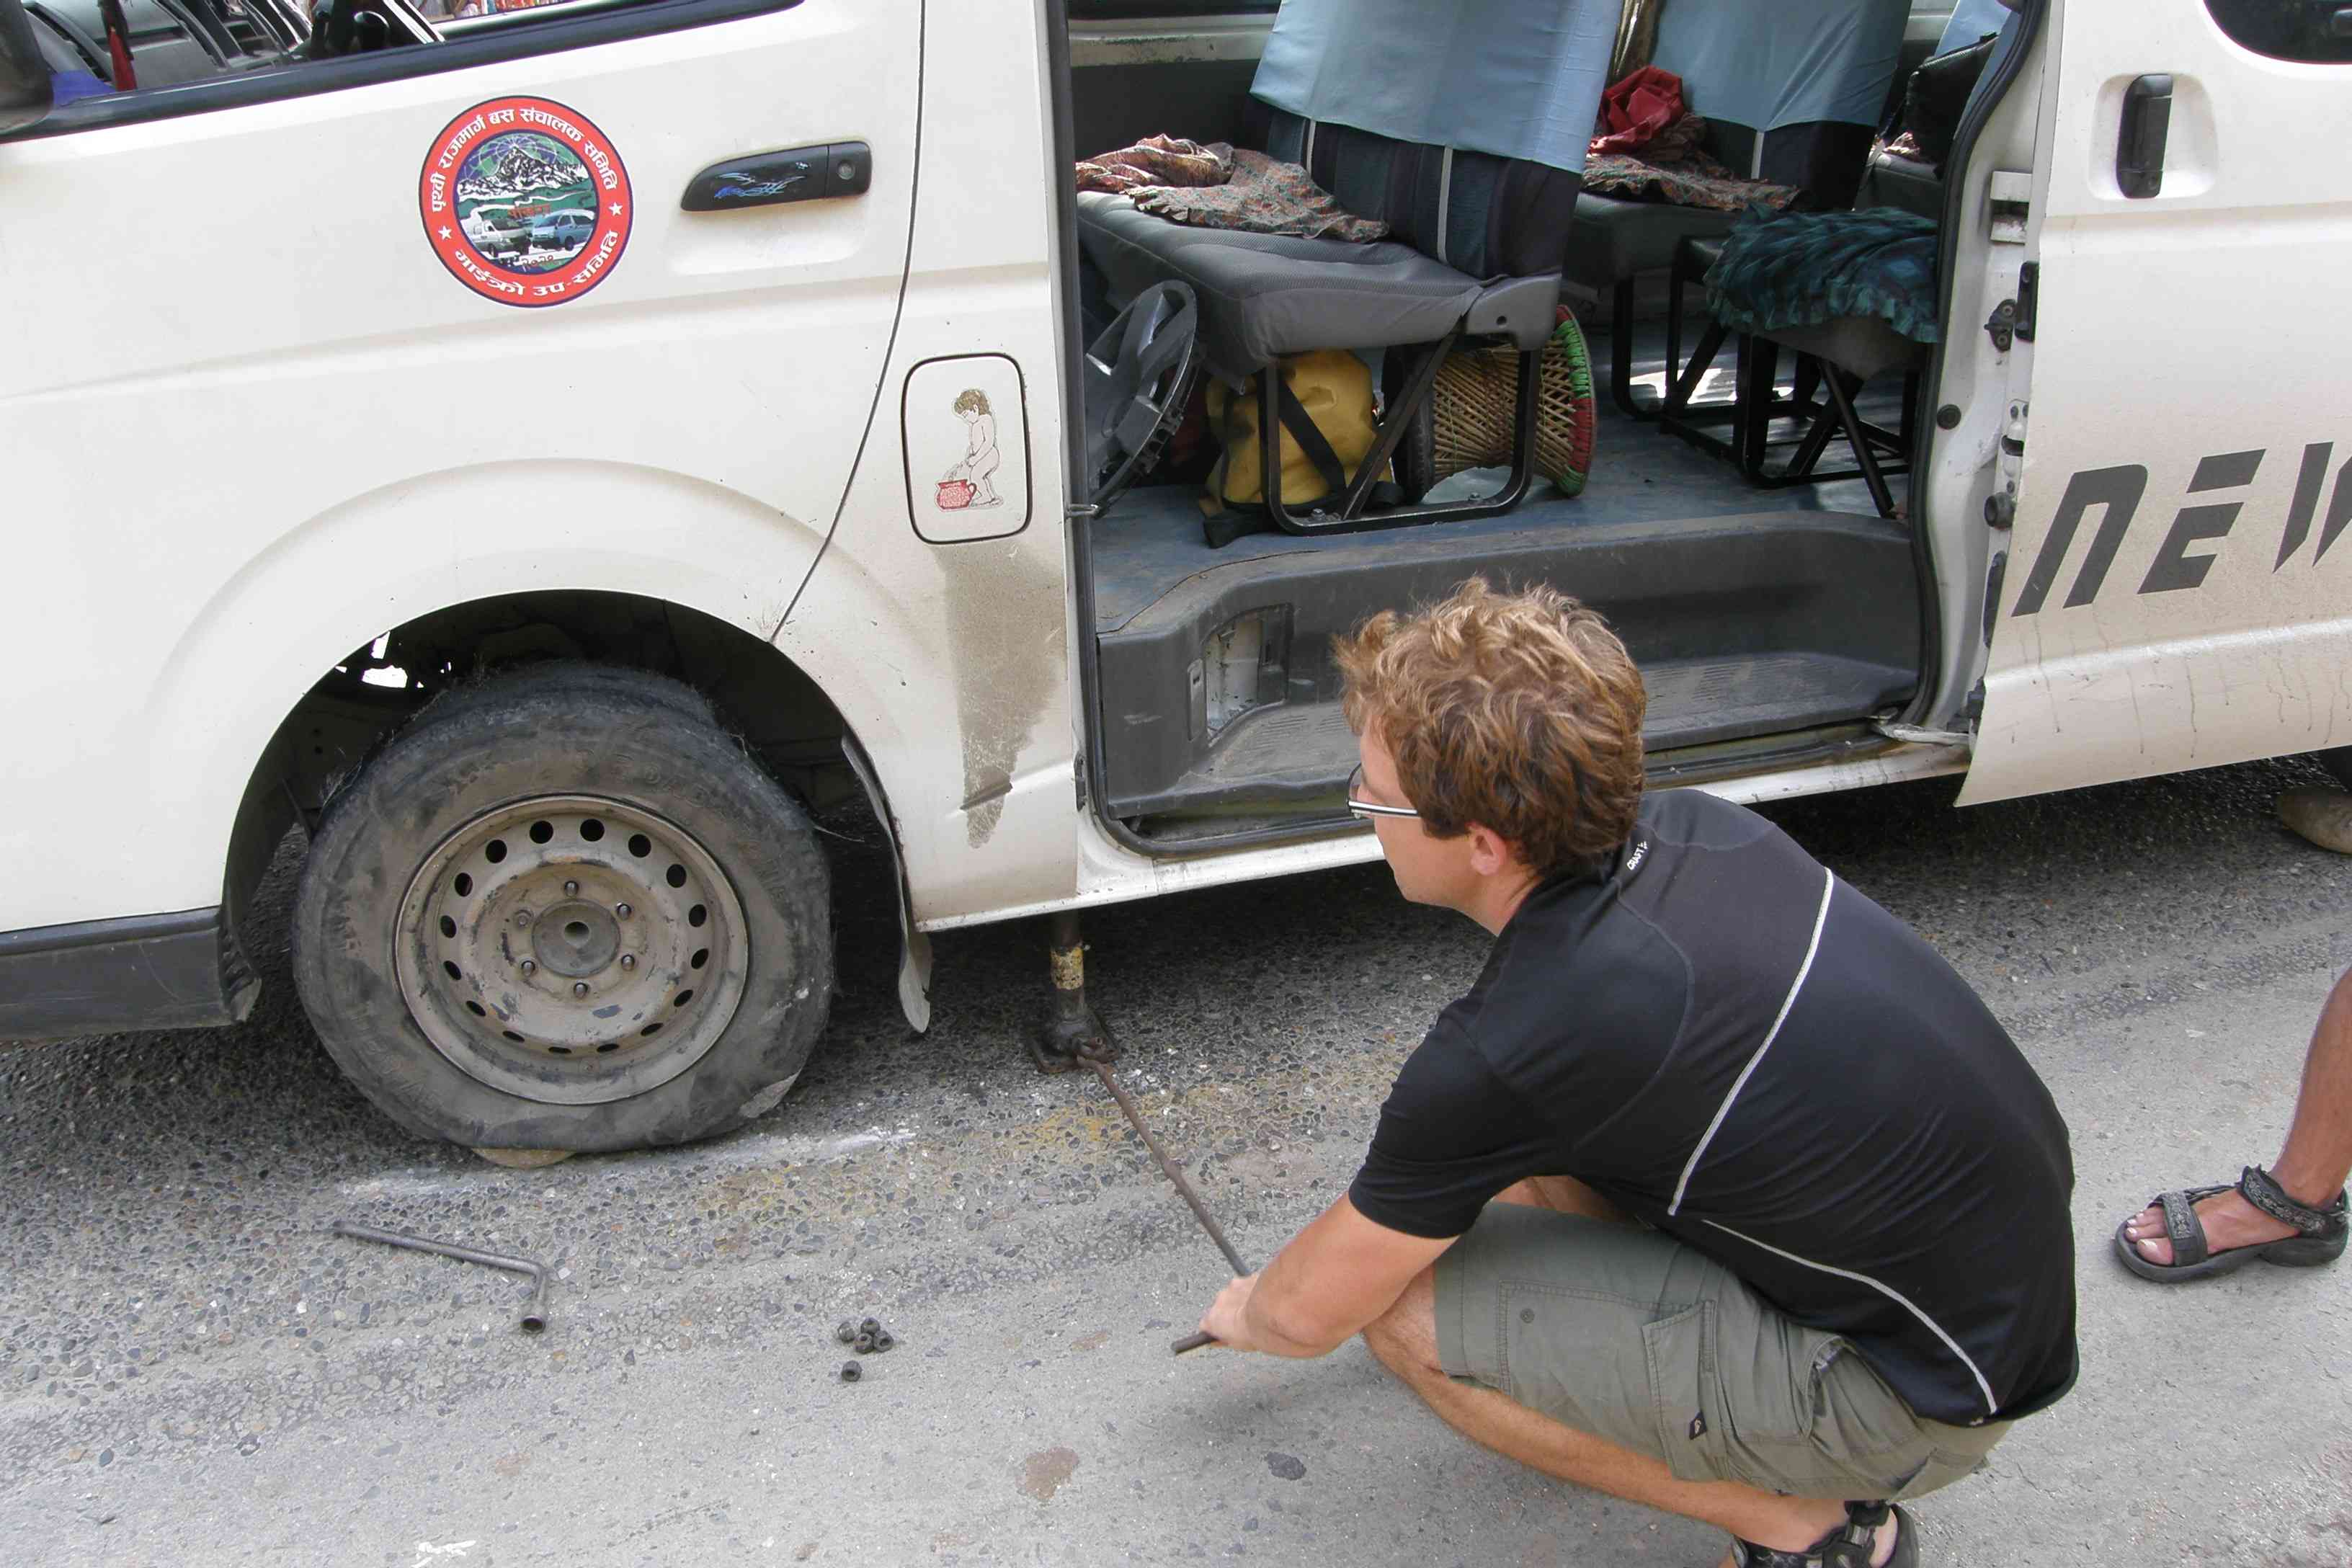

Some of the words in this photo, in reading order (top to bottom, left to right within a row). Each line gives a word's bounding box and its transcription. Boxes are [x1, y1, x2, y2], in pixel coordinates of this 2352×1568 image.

[438, 114, 486, 169] राजमार्ग
[488, 109, 514, 125] बस
[520, 107, 584, 141] संचालक
[584, 140, 618, 190] समिति
